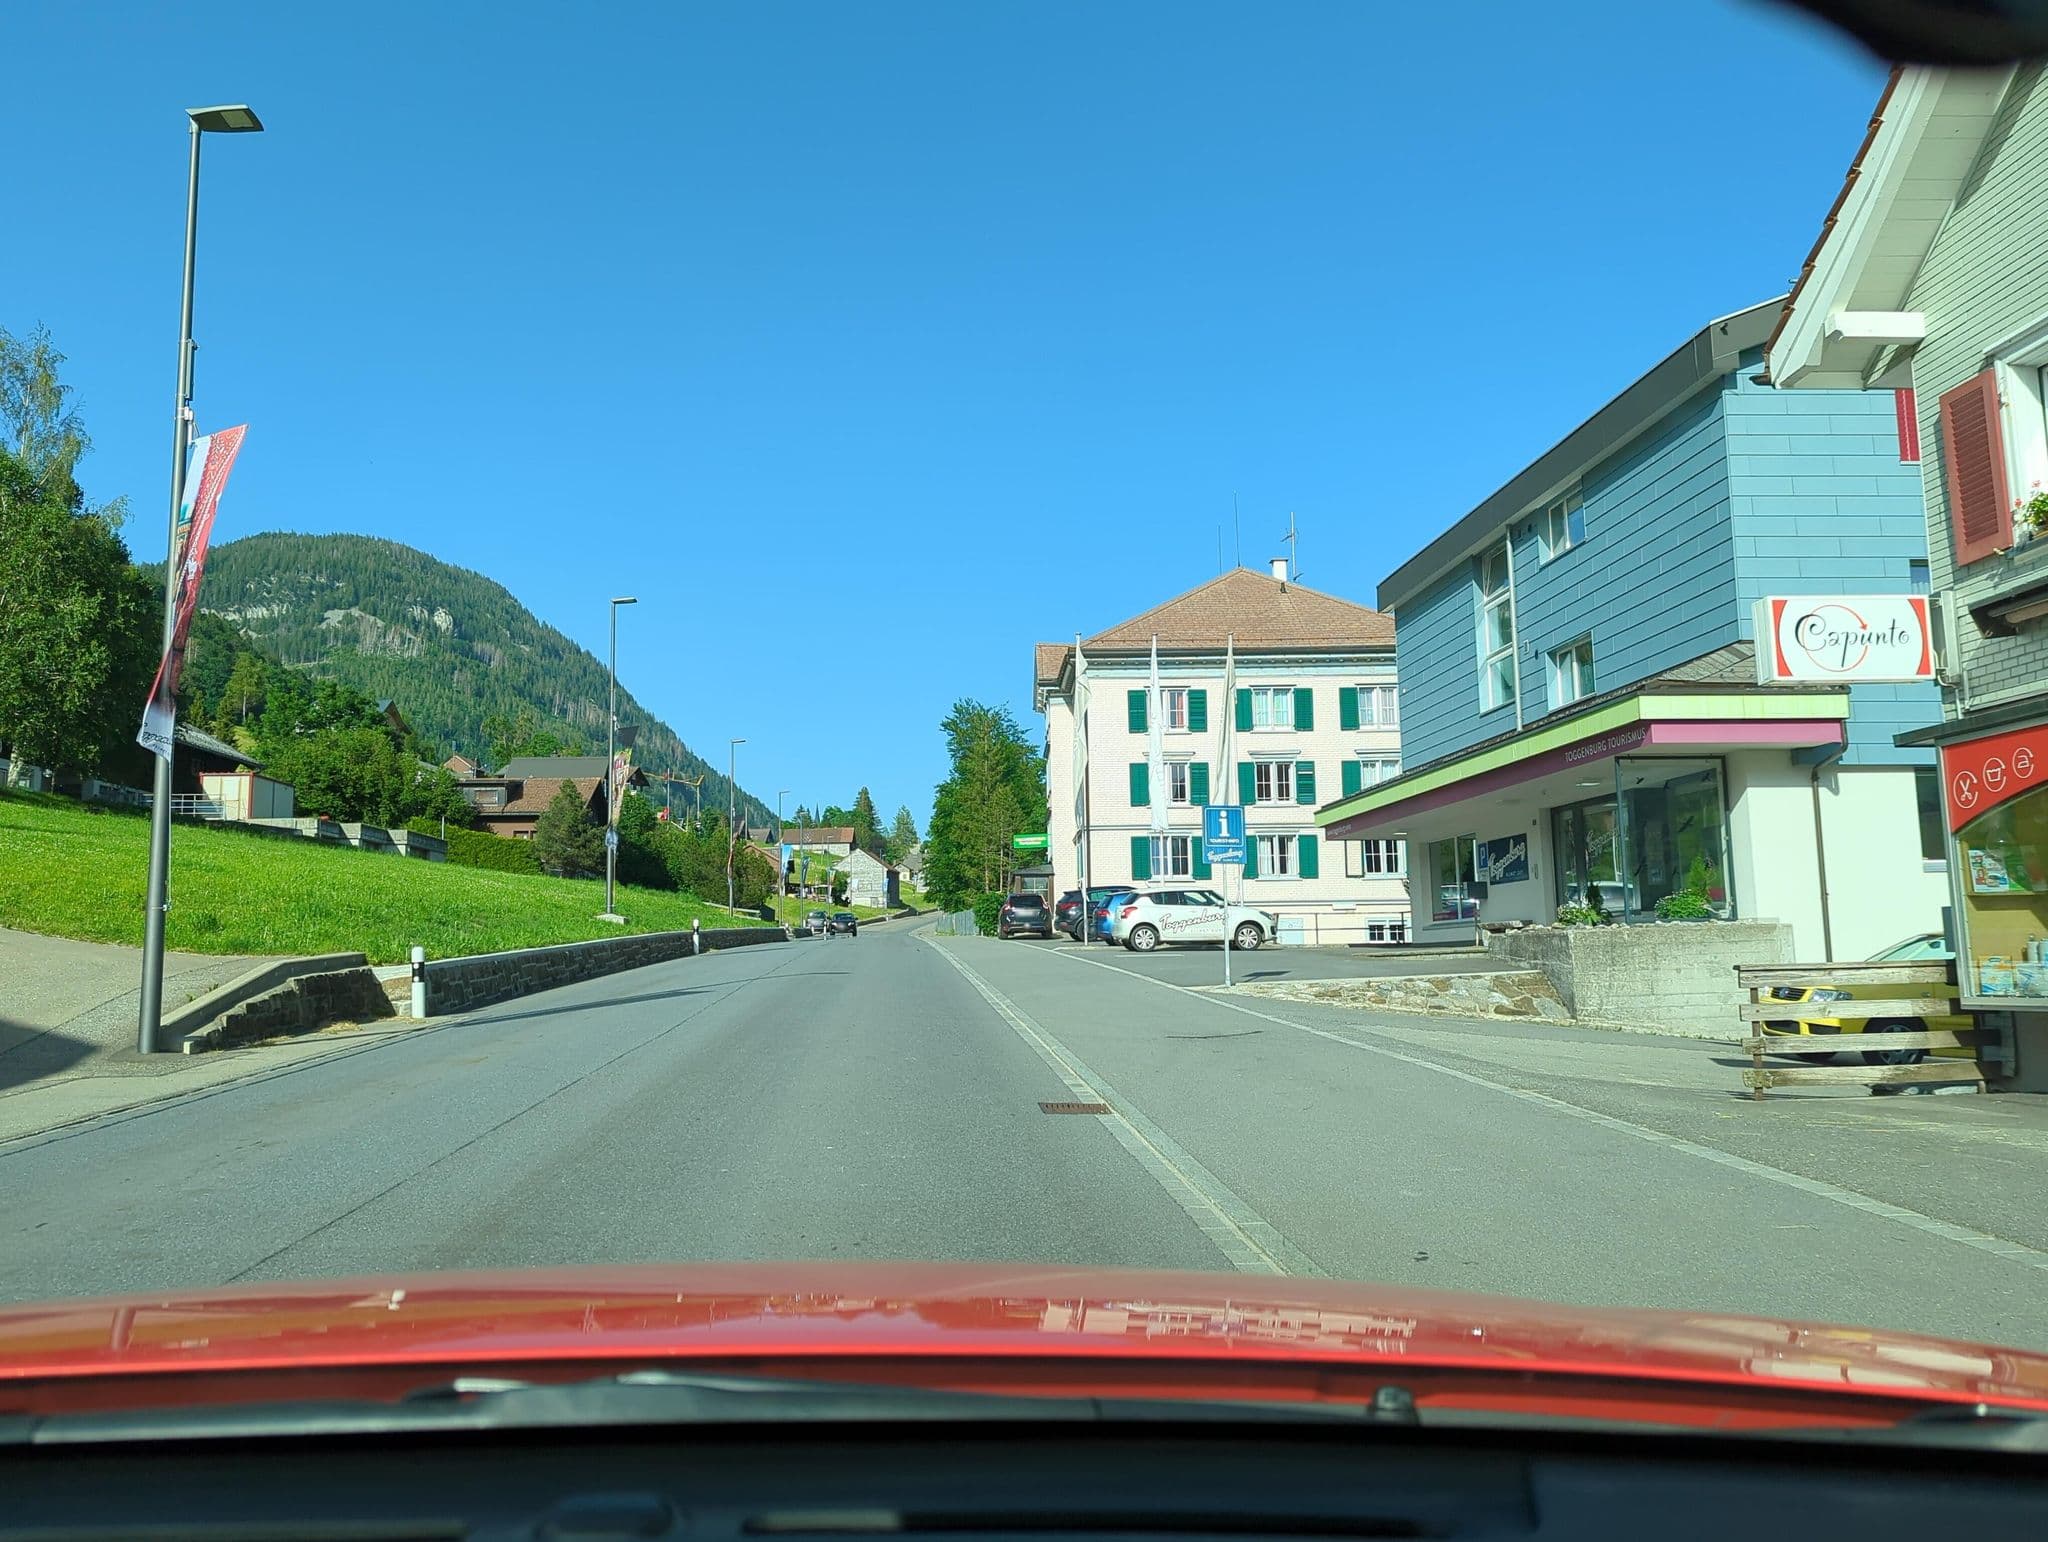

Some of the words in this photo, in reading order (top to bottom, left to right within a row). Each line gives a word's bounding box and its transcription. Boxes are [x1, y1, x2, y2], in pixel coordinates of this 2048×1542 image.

[1795, 613, 1910, 668] Capunto
[1564, 740, 1607, 763] TOGGENBURG
[1607, 727, 1647, 750] TOURISMUS
